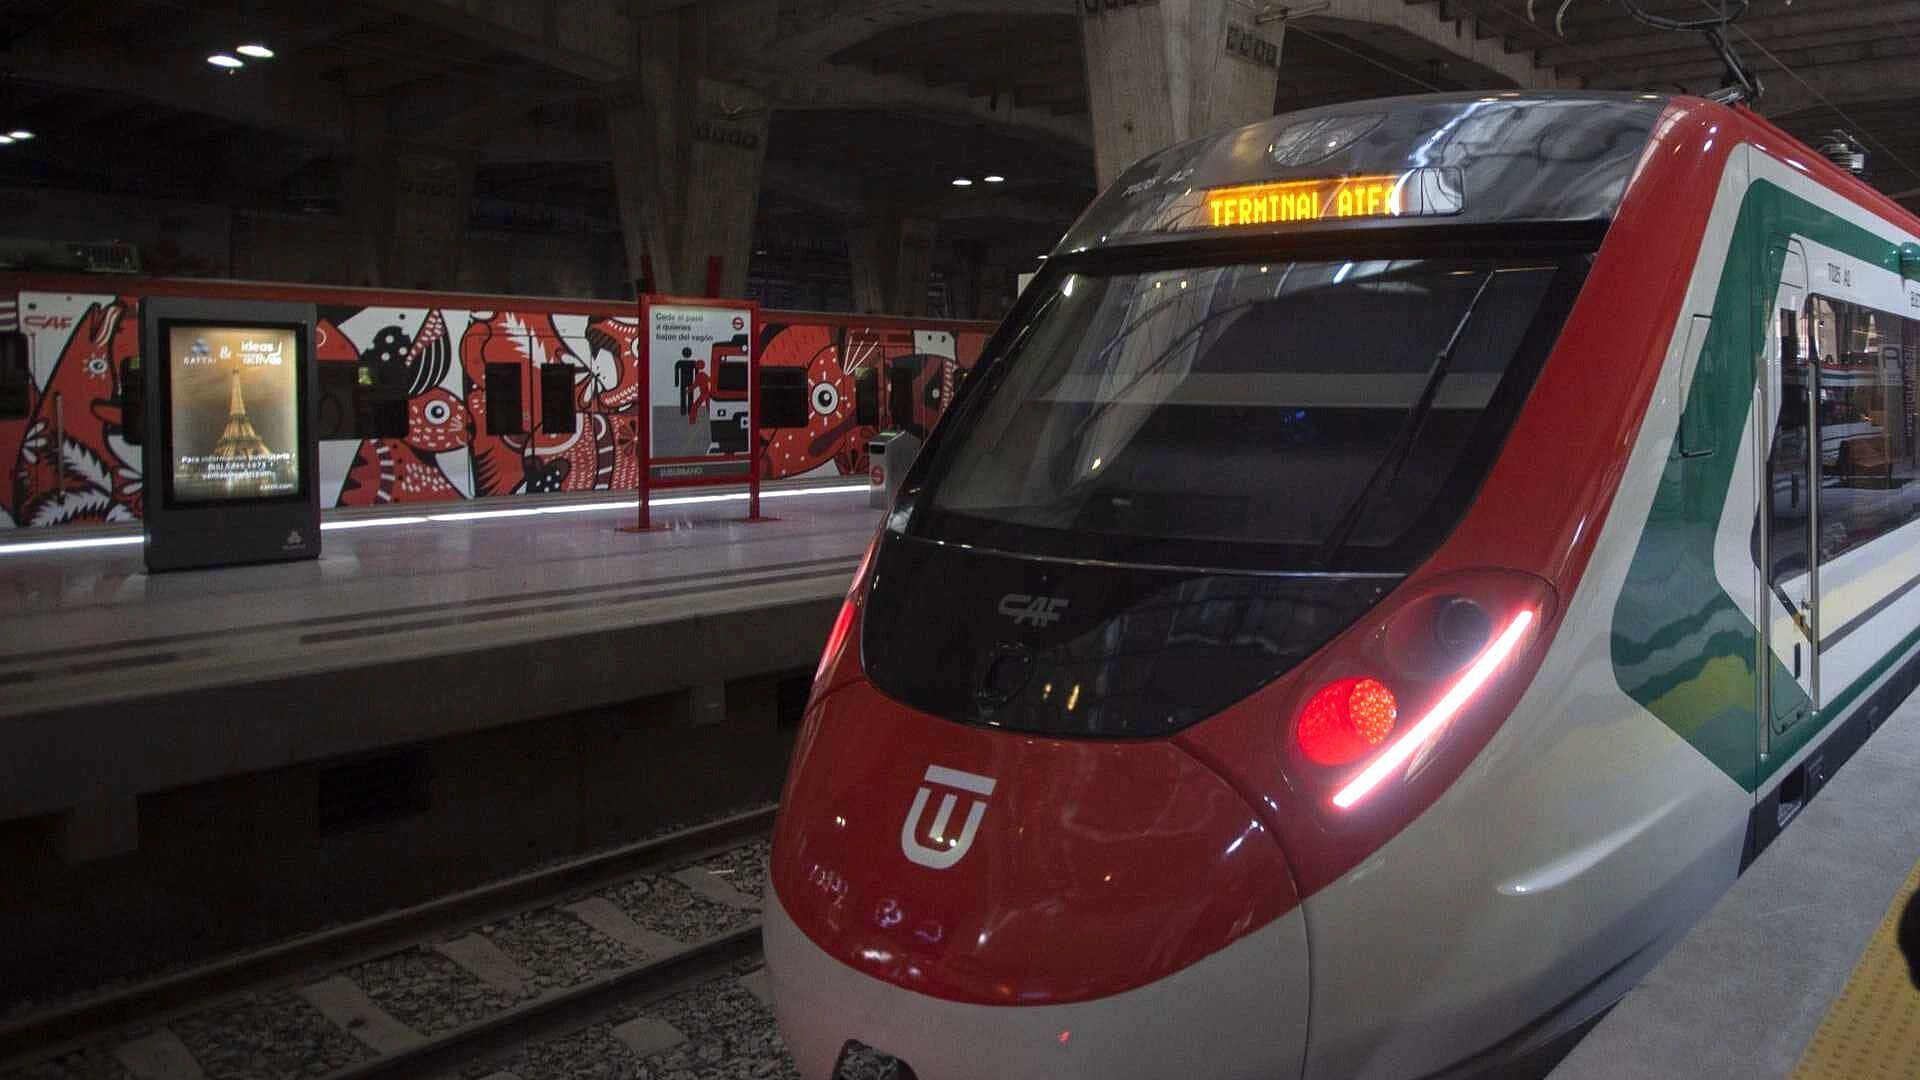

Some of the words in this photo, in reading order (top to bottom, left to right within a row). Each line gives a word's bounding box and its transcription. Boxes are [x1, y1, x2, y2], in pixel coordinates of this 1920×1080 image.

[1211, 191, 1319, 227] TERMINAL
[22, 315, 73, 329] CAF
[662, 325, 691, 333] quienes
[655, 333, 678, 342] bajen
[679, 333, 690, 341] del
[692, 334, 714, 343] vagón
[998, 593, 1070, 626] CAF
